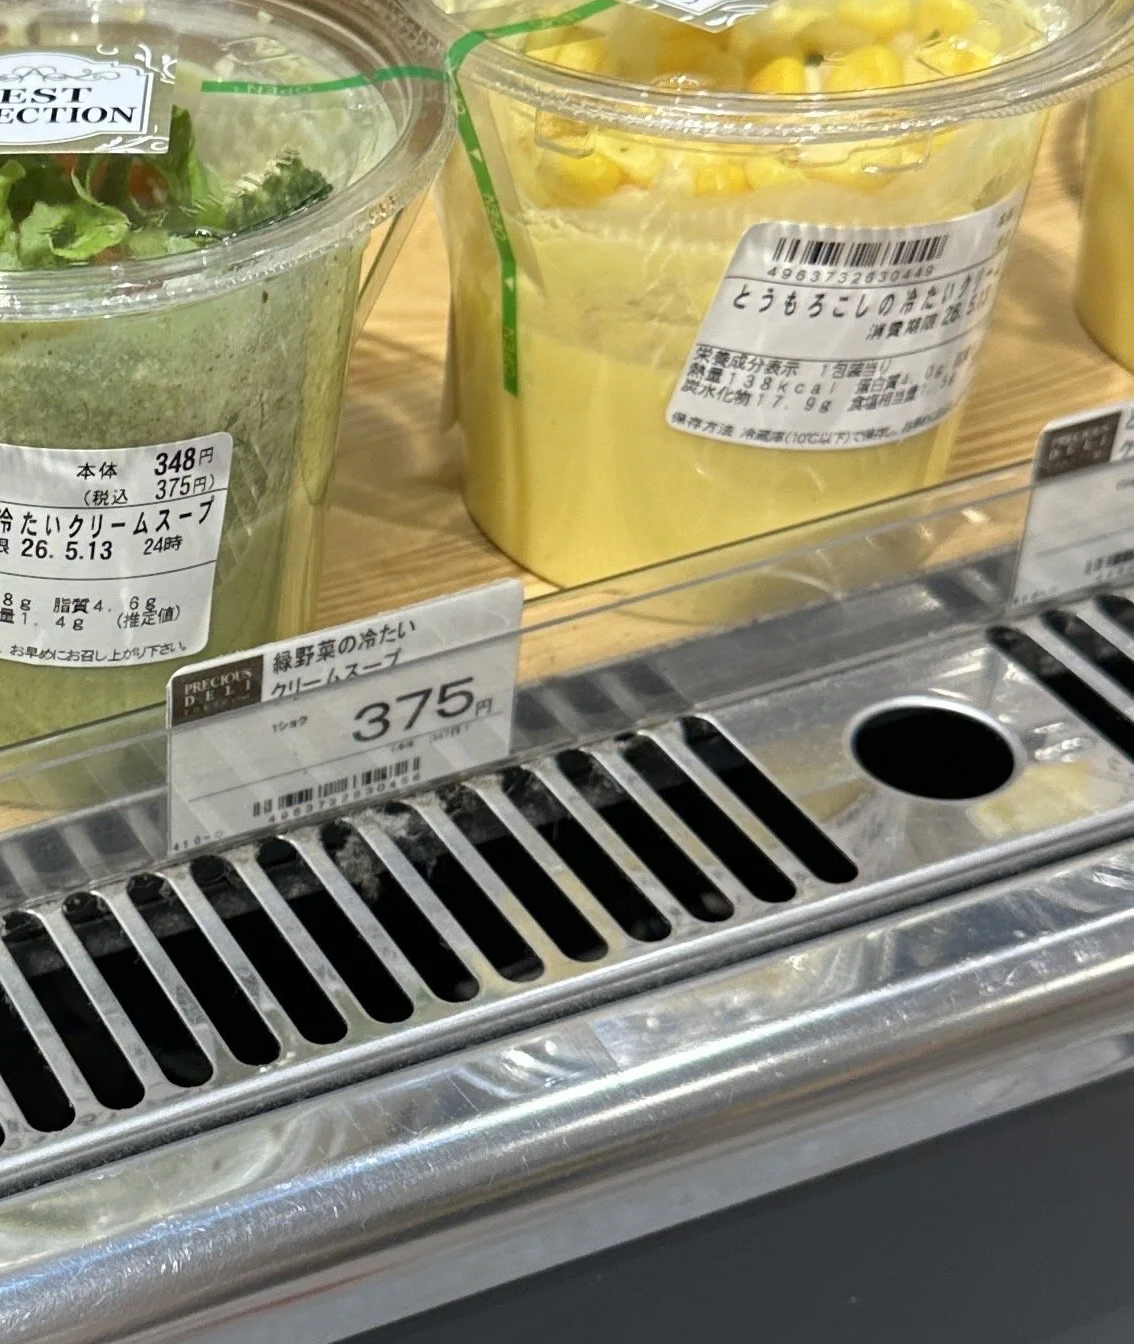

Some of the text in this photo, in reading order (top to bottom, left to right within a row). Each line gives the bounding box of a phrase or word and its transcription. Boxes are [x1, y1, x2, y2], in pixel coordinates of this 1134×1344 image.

[767, 264, 935, 284] 4963732630449
[694, 346, 800, 377] 栄養成分表示
[77, 446, 215, 480] 本体 348円
[143, 534, 184, 556] 24時
[116, 605, 181, 630] (推定値)
[272, 621, 415, 675] 緑野菜の冷たい
[184, 668, 252, 695] PRECIOUS
[271, 648, 402, 697] クリームスープ
